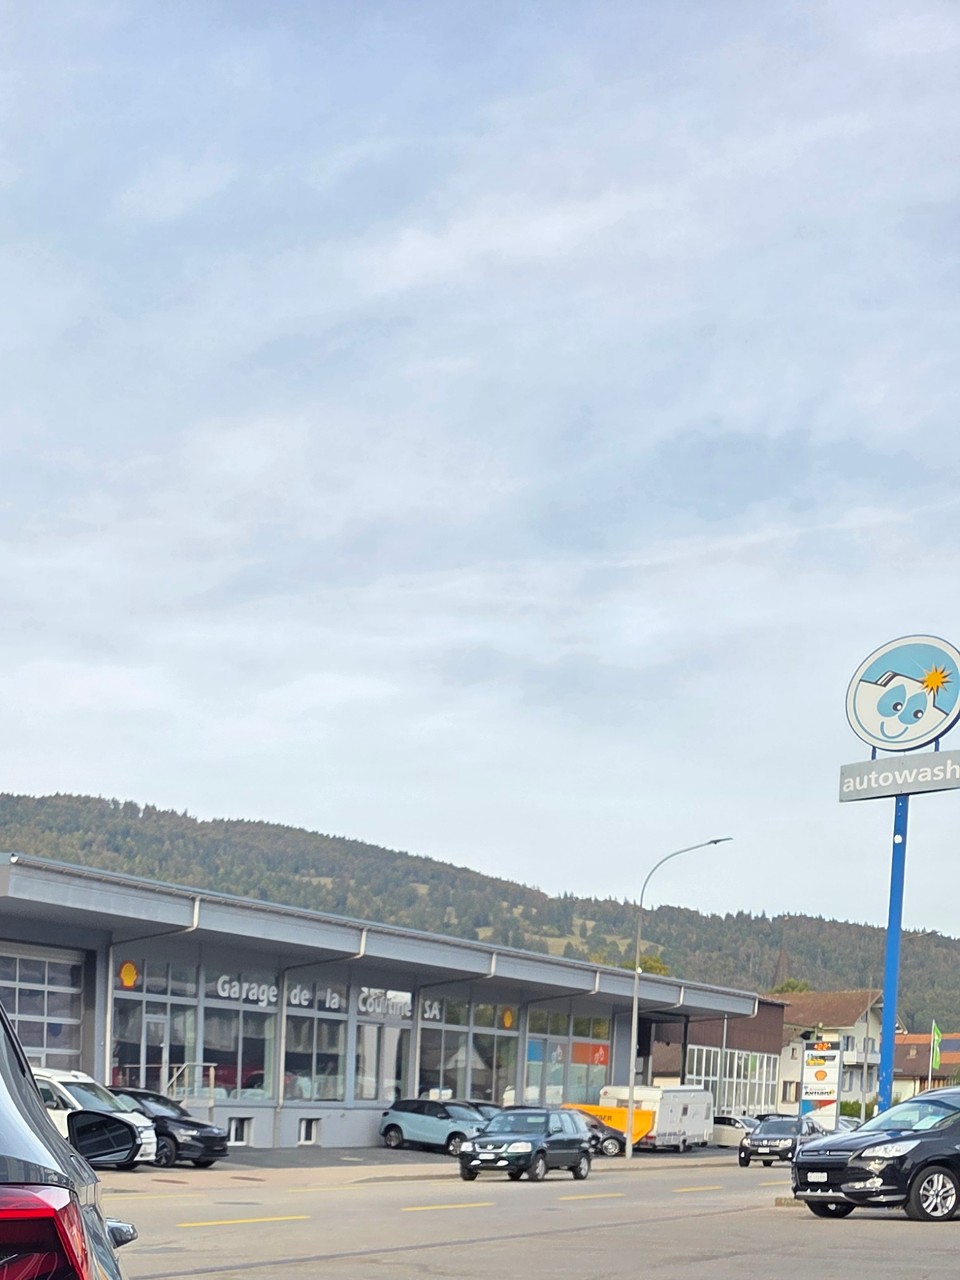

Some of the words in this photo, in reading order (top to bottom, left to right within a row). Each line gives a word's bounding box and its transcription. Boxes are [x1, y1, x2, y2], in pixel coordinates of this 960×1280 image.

[842, 759, 960, 792] autowash
[216, 975, 278, 1007] Garage
[290, 984, 310, 1006] de
[325, 988, 340, 1009] la
[358, 990, 412, 1017] Courtine
[423, 1000, 440, 1020] SA
